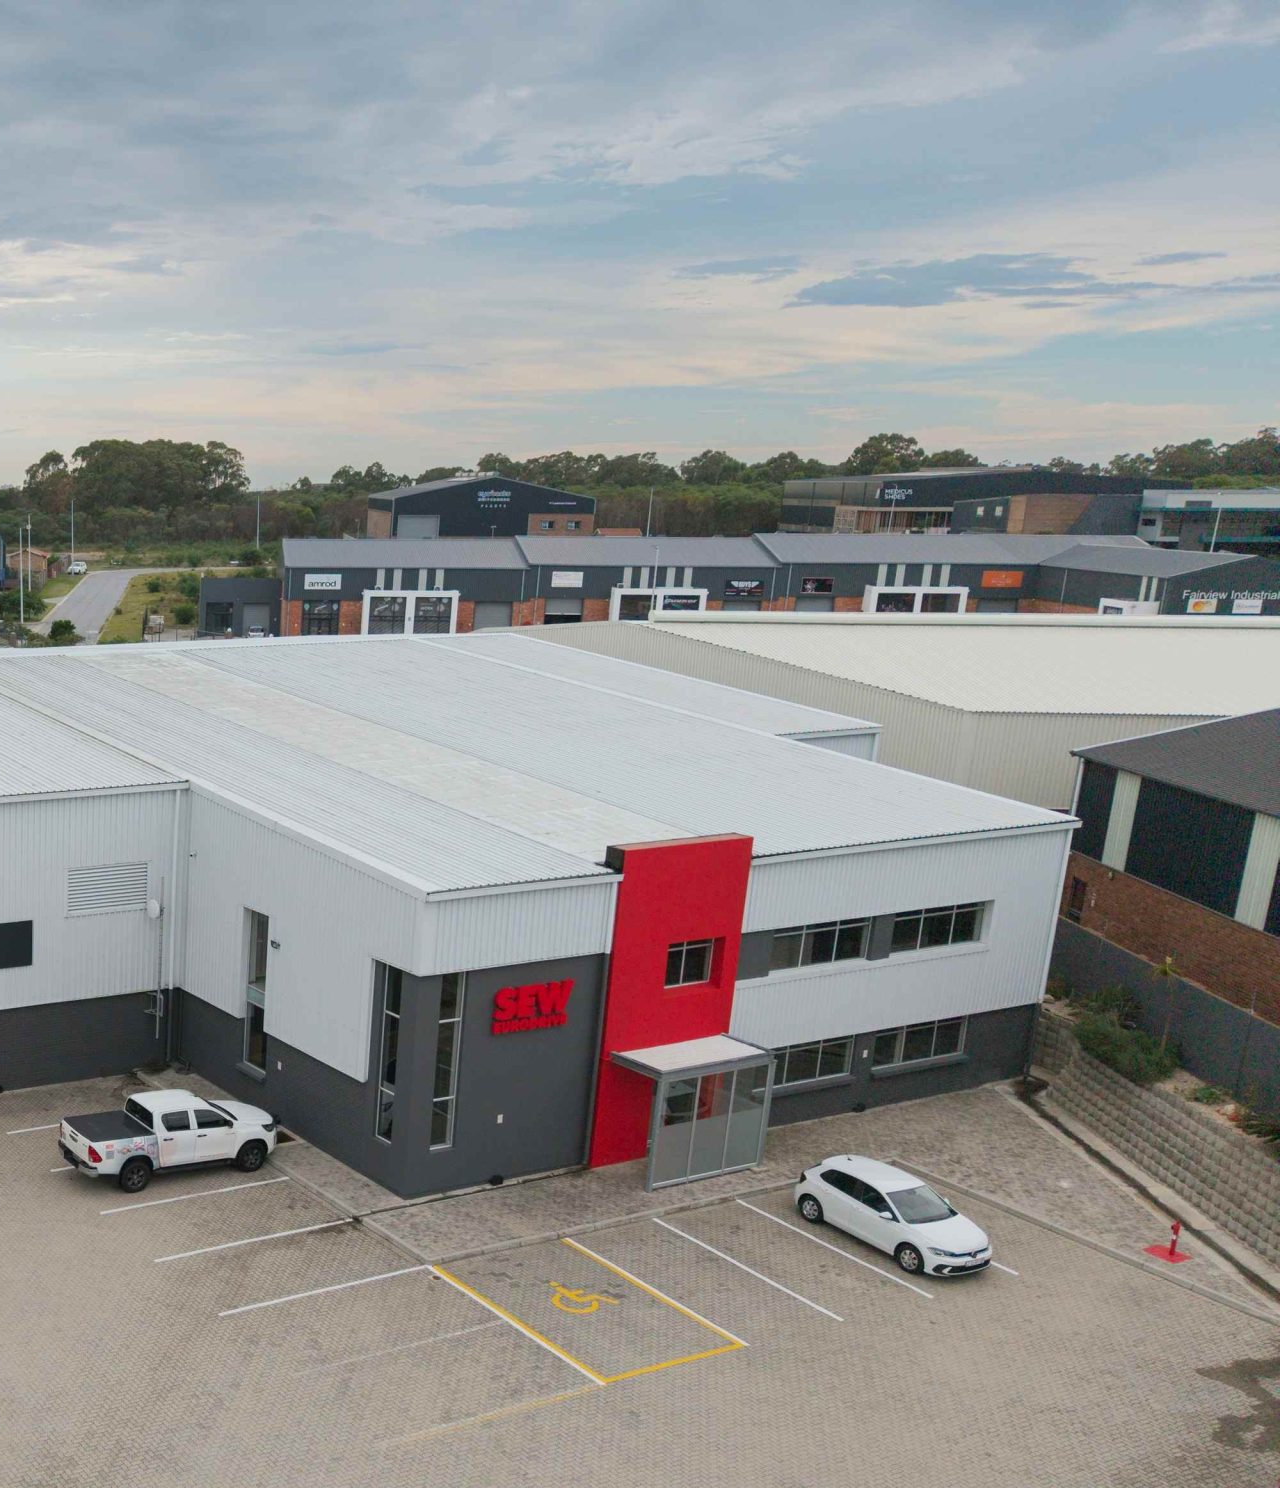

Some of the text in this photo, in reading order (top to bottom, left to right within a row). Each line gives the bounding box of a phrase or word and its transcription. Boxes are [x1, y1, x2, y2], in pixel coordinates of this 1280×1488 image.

[308, 580, 337, 588] amrod
[1182, 589, 1280, 600] Fairview Industrial
[492, 977, 575, 1021] SEW
